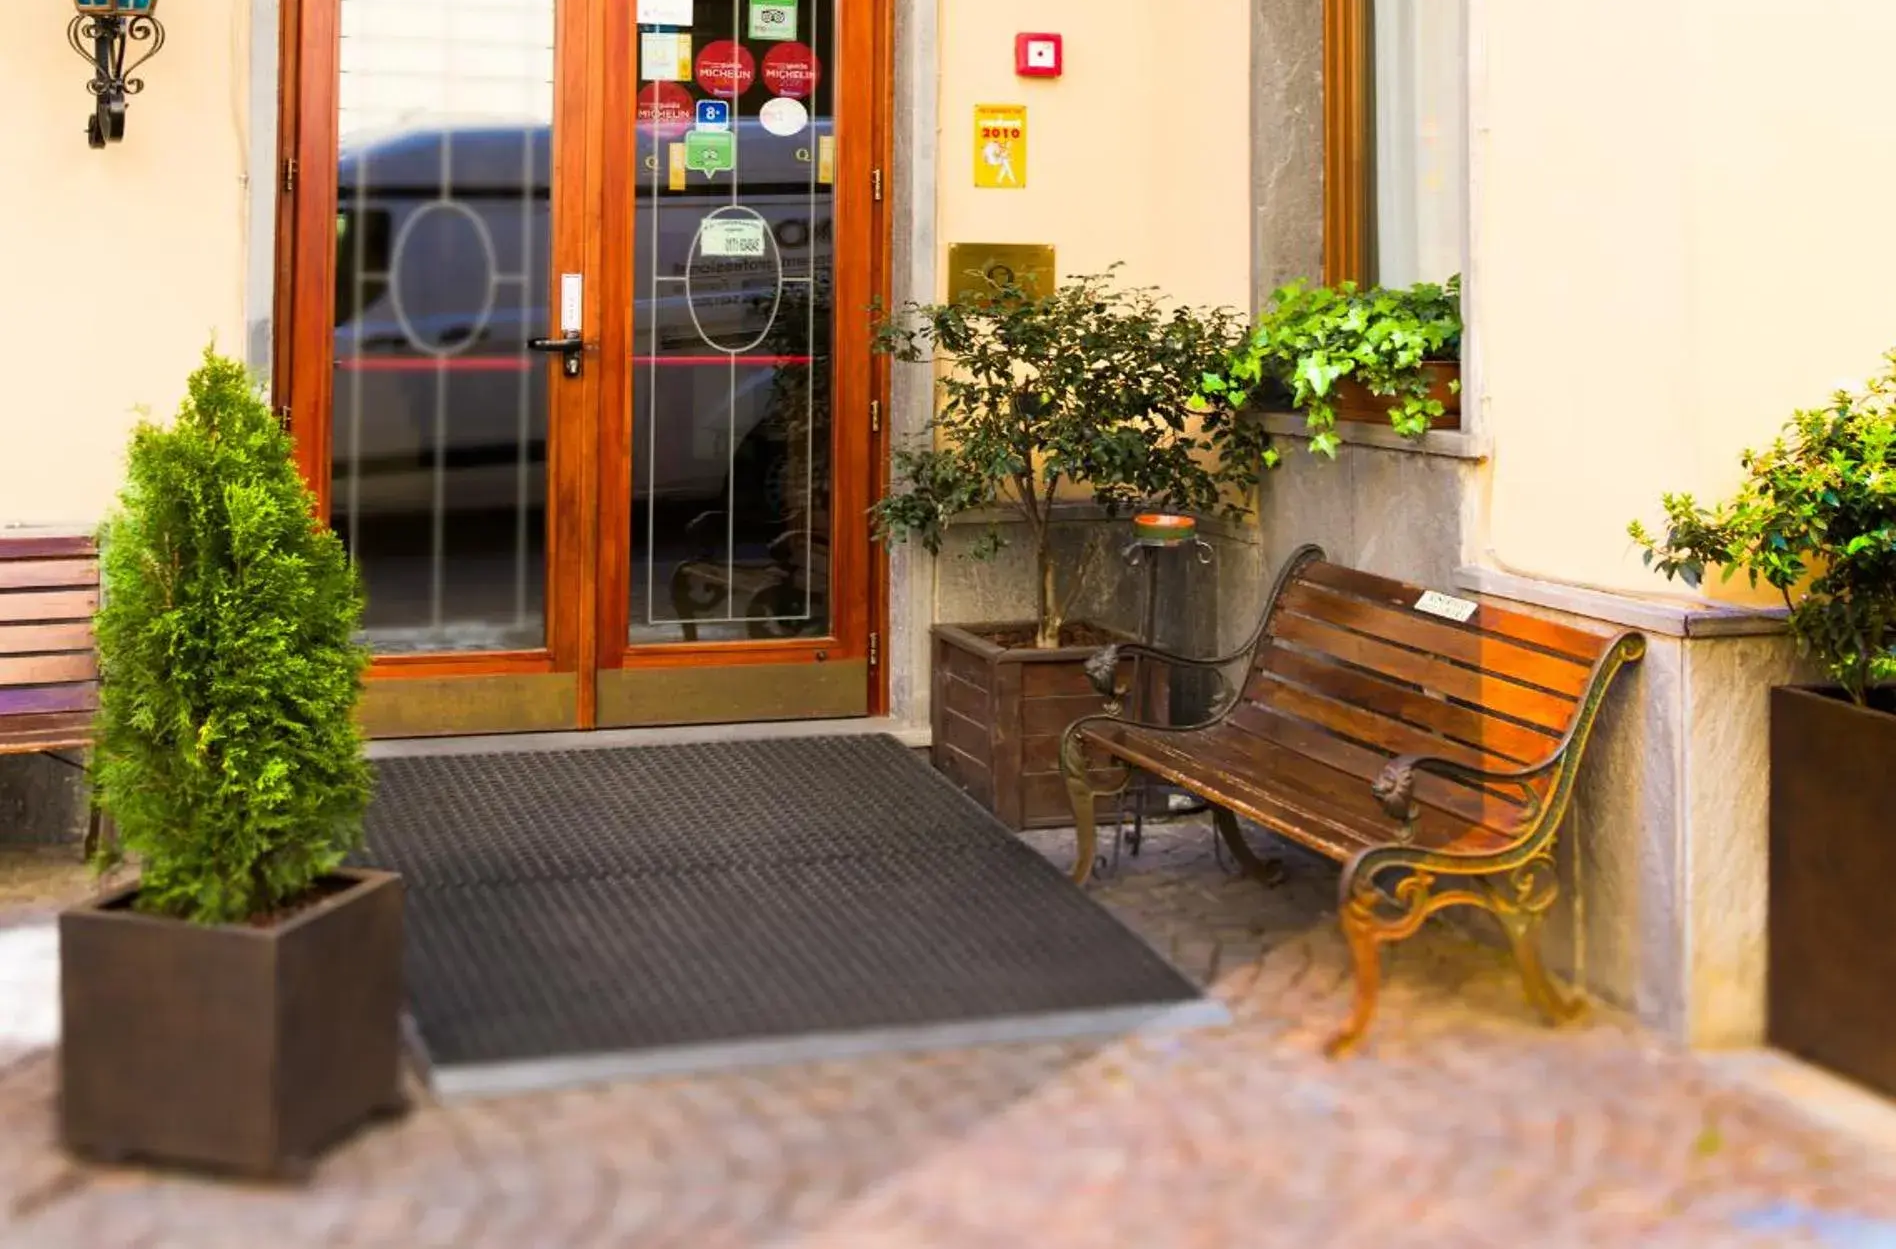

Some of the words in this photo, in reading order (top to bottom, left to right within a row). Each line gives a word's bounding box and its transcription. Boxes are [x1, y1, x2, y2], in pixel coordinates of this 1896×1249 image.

[699, 68, 751, 79] MICHELIN
[765, 69, 815, 79] MICHELIN
[638, 109, 690, 119] MICHELIN
[982, 128, 1020, 138] 2010
